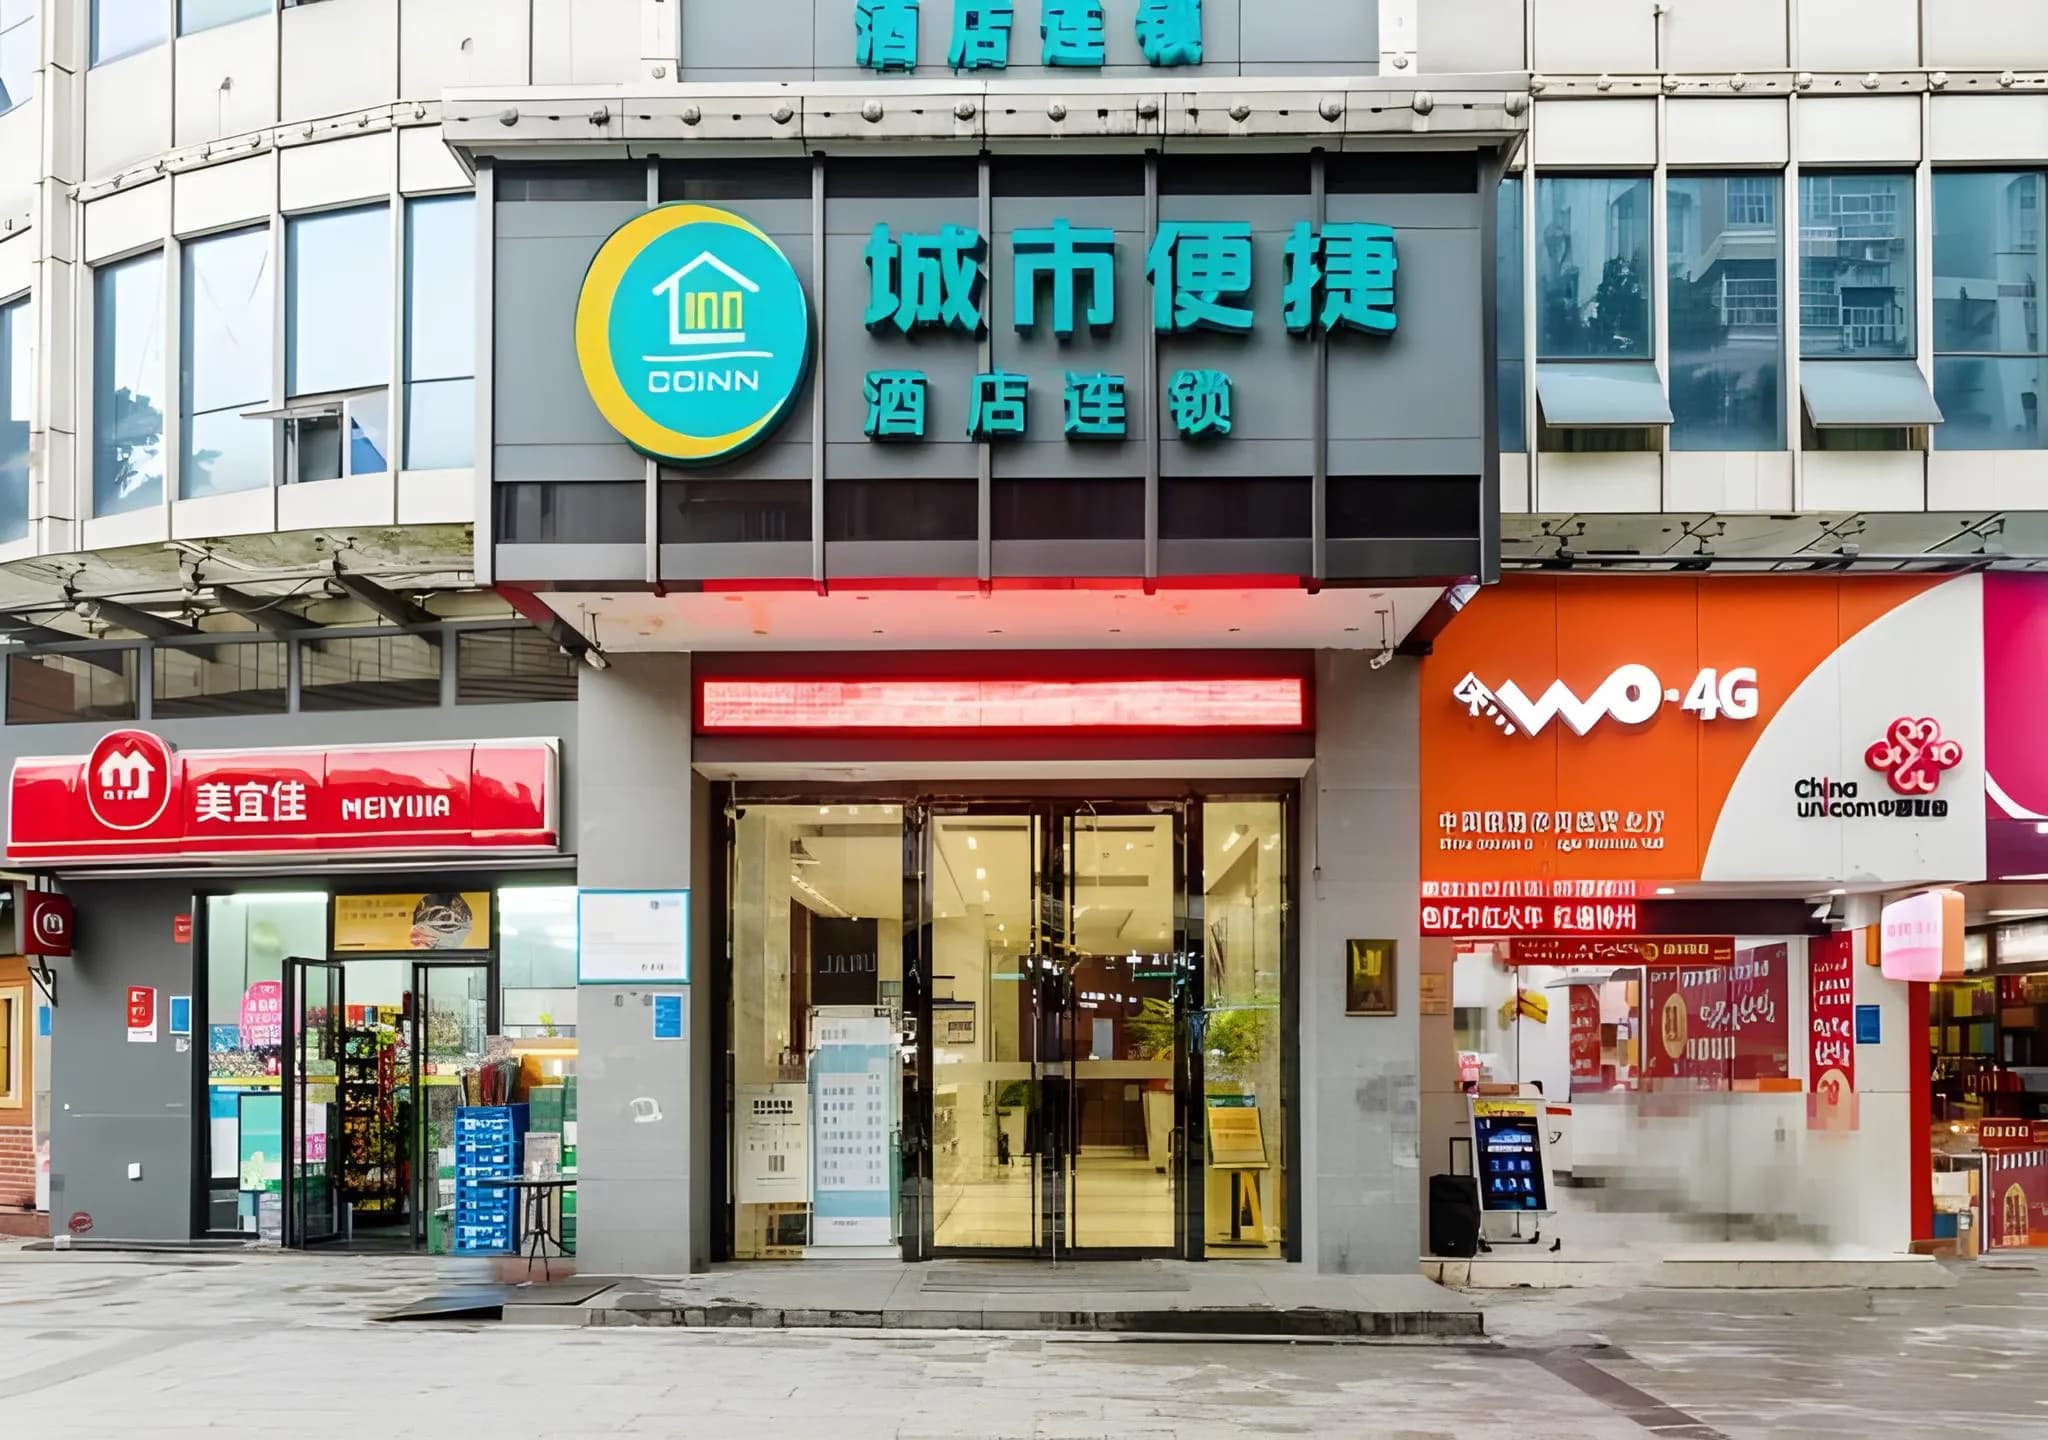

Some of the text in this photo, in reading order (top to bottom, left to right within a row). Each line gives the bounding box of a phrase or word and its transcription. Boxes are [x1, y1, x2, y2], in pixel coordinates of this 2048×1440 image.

[865, 218, 1398, 338] 城市便捷
[864, 368, 1233, 441] 酒店连锁
[195, 781, 308, 823] 美宜佳
